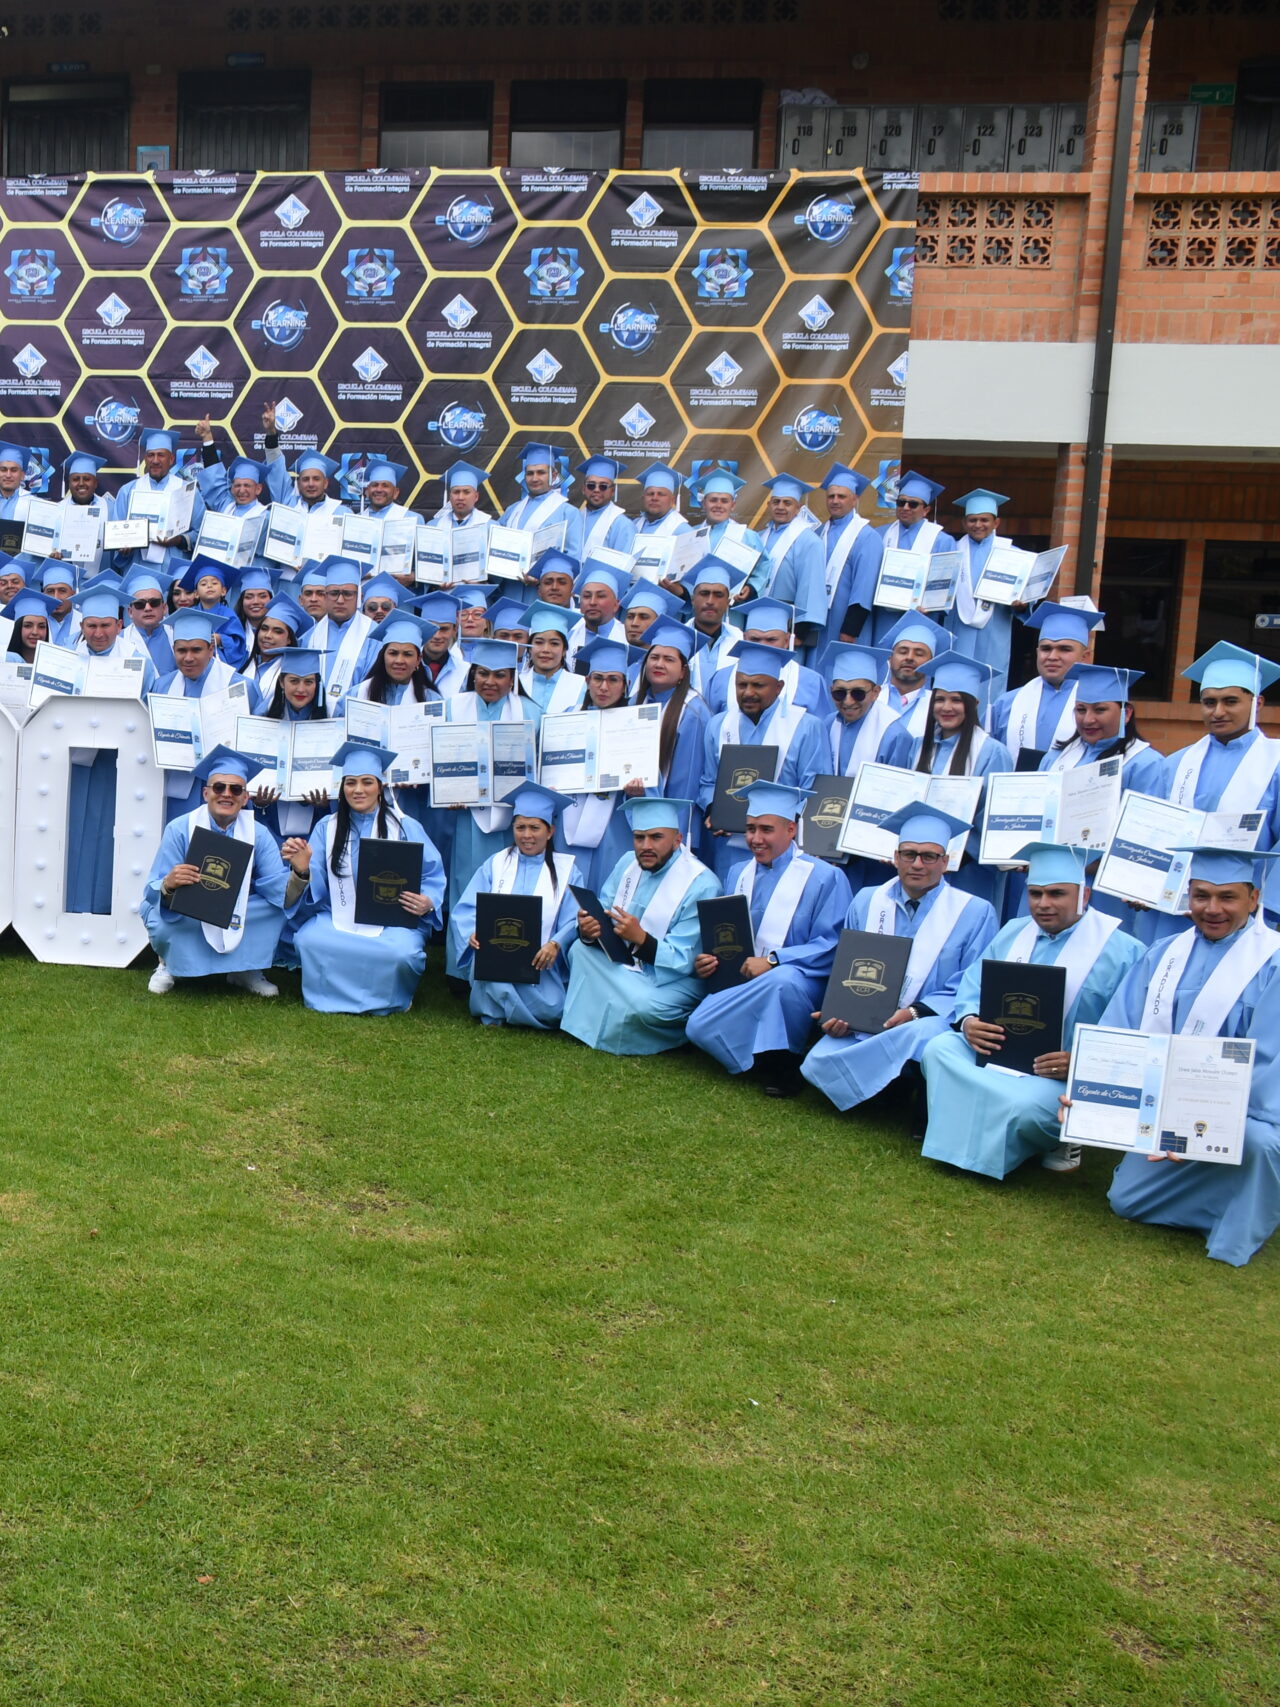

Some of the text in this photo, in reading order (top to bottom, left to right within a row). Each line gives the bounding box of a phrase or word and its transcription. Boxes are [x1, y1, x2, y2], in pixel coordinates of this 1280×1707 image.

[797, 125, 813, 137] 118
[841, 126, 857, 137] 119
[884, 125, 902, 136] 120
[977, 126, 995, 137] 122
[1024, 125, 1042, 137] 123
[386, 185, 409, 193] Integral
[300, 240, 323, 248] Integral
[653, 240, 677, 248] Integral
[122, 338, 144, 346] Integral
[468, 341, 491, 349] Integral
[825, 343, 849, 352] Integral
[210, 391, 233, 399] Integral
[378, 393, 401, 401] Integral
[552, 396, 576, 404] Integral
[690, 398, 698, 406] de
[733, 399, 757, 407] Integral
[646, 451, 669, 459] Integral
[1019, 714, 1027, 747] GRADUA
[622, 877, 631, 907] GRADU
[1153, 957, 1175, 1015] GRADUADO
[1078, 1085, 1100, 1096] Agente
